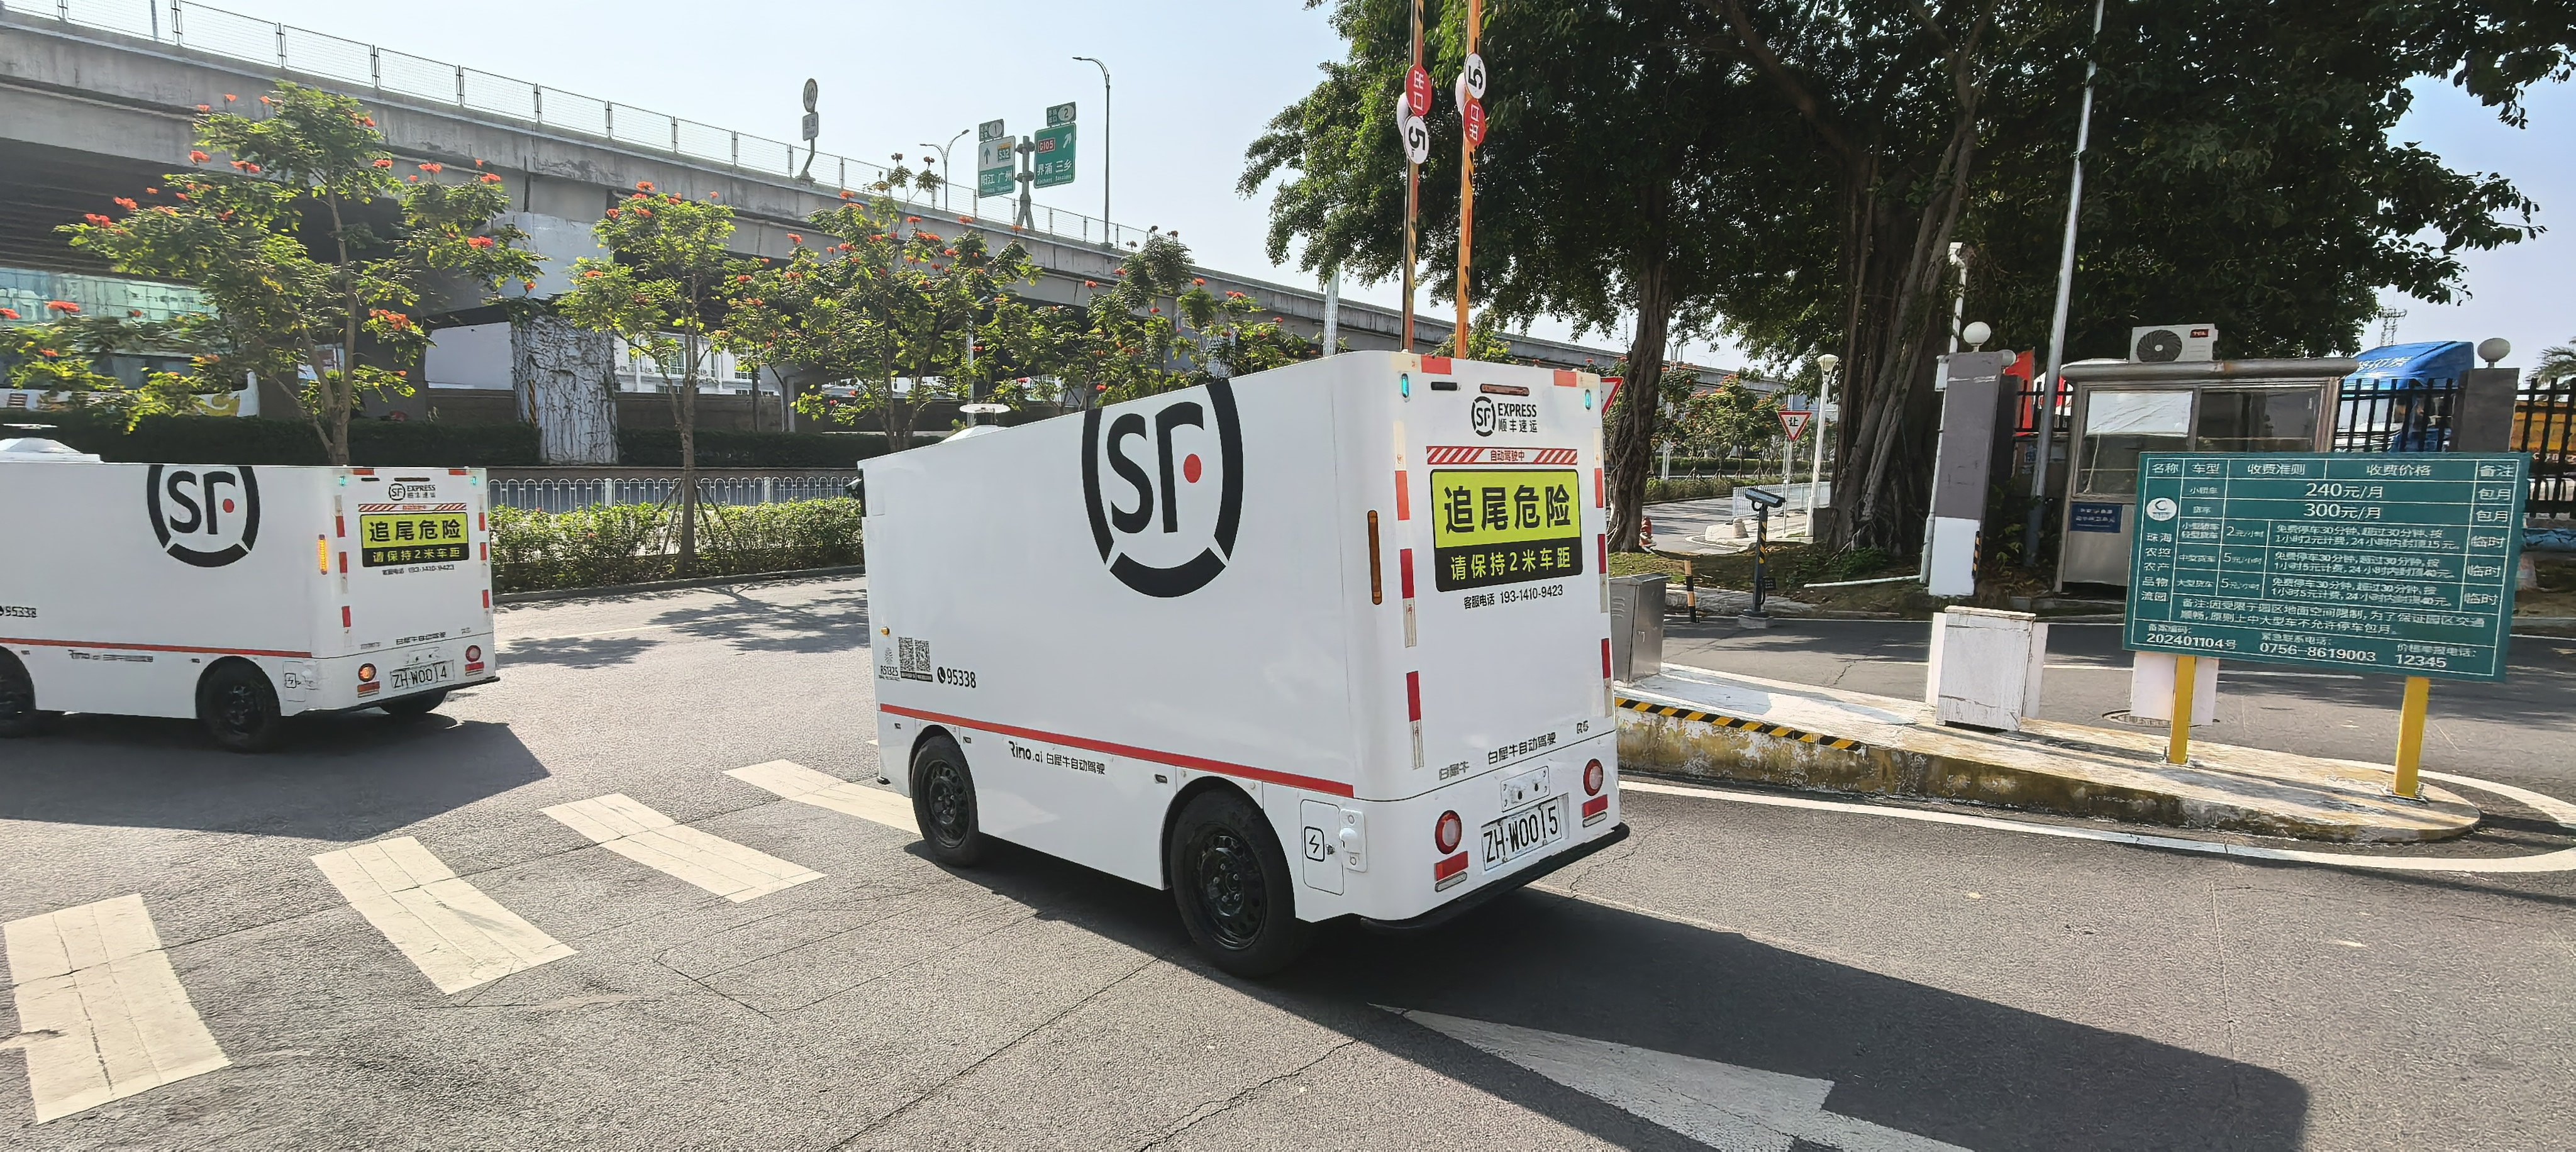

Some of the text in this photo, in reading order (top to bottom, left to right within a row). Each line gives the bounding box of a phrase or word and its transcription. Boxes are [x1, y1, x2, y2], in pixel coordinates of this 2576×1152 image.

[1468, 65, 1483, 90] 5
[1413, 70, 1424, 111] 出口
[1064, 108, 1069, 118] 2
[1469, 104, 1480, 141] 出口
[1039, 140, 1054, 152] G105
[1409, 126, 1426, 151] 5
[1055, 159, 1072, 173] 三乡
[980, 170, 1013, 186] 阳江 广州
[1476, 402, 1537, 427] SF EXPRESS
[1498, 418, 1538, 433] 顺丰速运
[1491, 449, 1525, 462] 自动驾驶中
[1107, 401, 1204, 534] SF
[2151, 463, 2180, 474] 名称
[2192, 463, 2220, 475] 车型
[2247, 463, 2306, 476] 收费准则
[2366, 463, 2432, 477] 收费价格
[2304, 482, 2384, 499] 240元/月
[2478, 487, 2512, 501] 包月
[167, 470, 235, 534] SF
[1443, 484, 1572, 534] 追尾危险
[2303, 502, 2382, 520] 300元/月
[2476, 510, 2509, 523] 包月
[369, 519, 461, 542] 追尾危险
[373, 548, 460, 563] 请保持2米车距
[1451, 546, 1571, 581] 请保持2米车距
[1463, 584, 1564, 610] 客服电话 193-1410-9423
[2146, 633, 2238, 650] 202401104号
[2260, 643, 2377, 662] 0756-8619003
[2395, 654, 2448, 668] 12345
[947, 668, 977, 689] 95338
[1487, 732, 1557, 765] 白犀牛自动驾驶
[1046, 753, 1106, 775] 白犀牛自动驾驶
